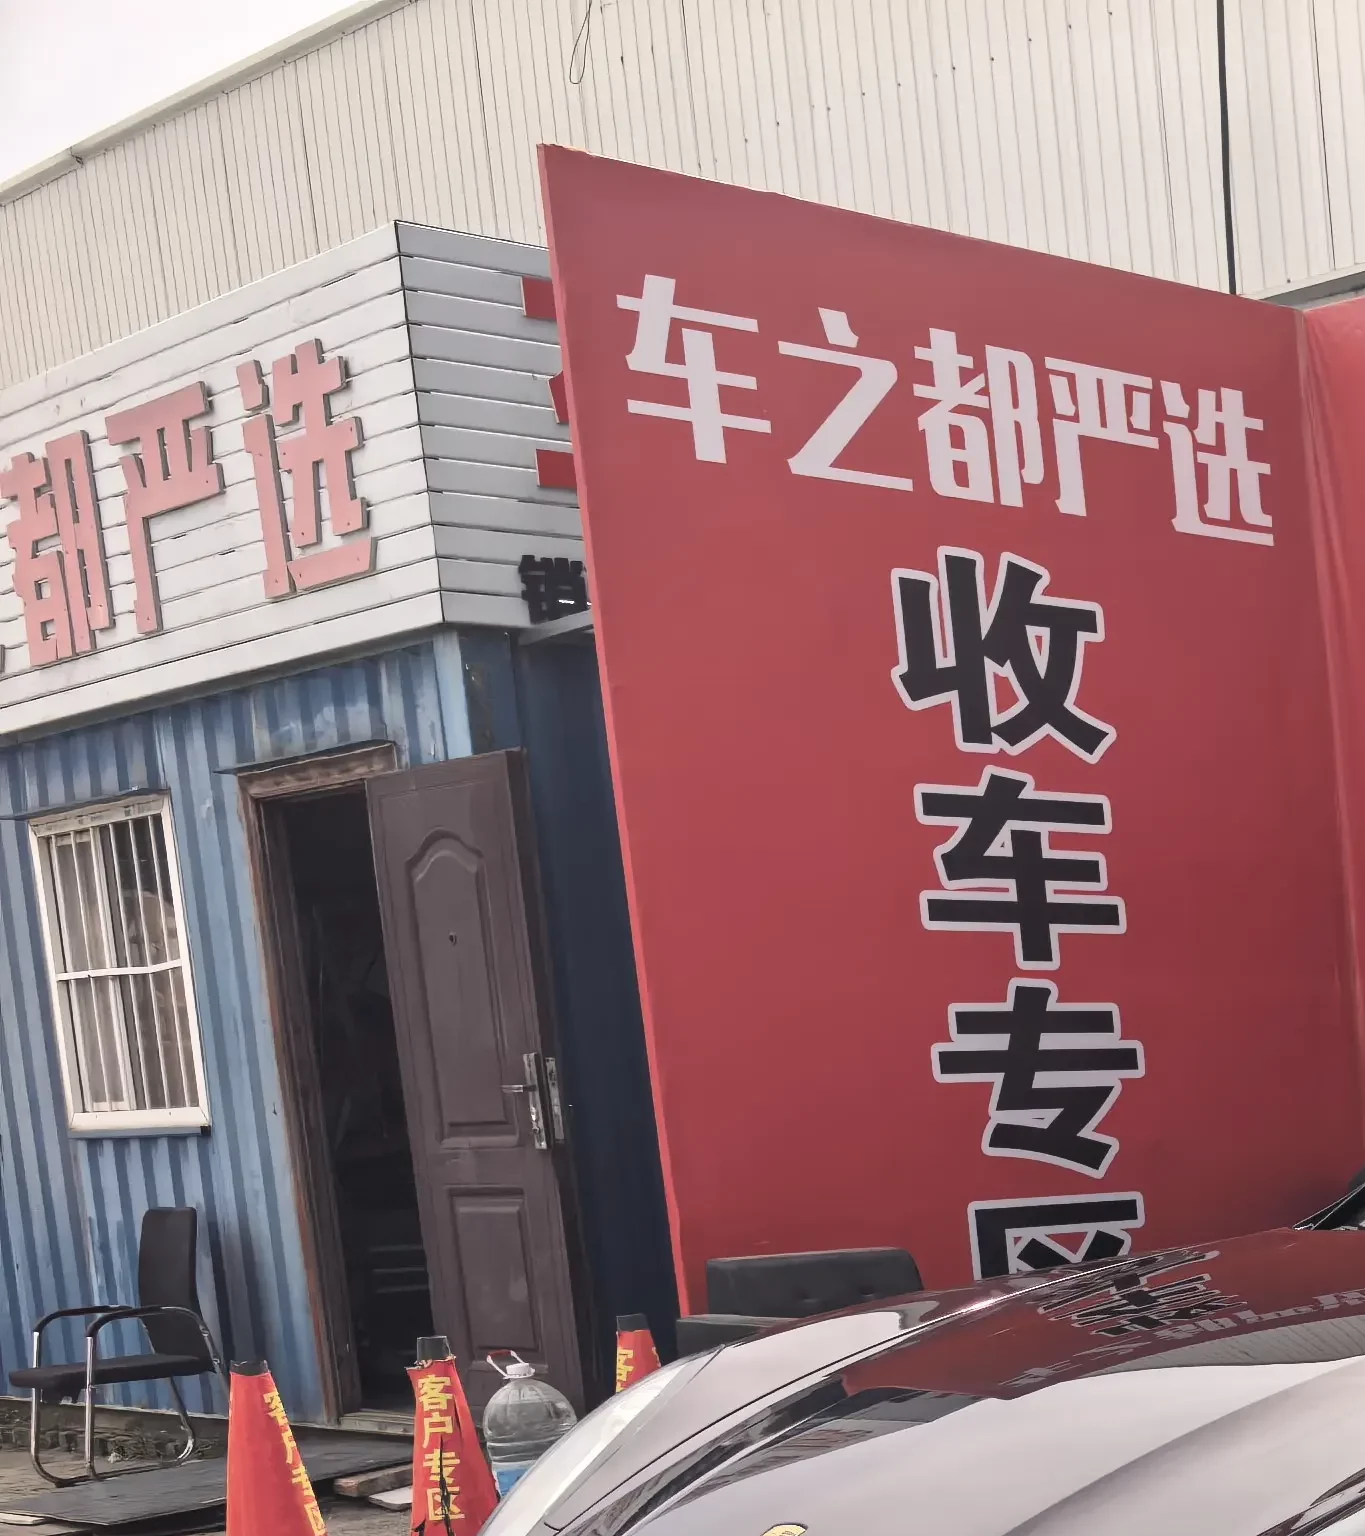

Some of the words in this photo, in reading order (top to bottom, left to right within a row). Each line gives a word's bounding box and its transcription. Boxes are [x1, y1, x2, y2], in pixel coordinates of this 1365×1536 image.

[616, 274, 1275, 547] 车之都严选
[416, 1374, 465, 1522] 客户专区
